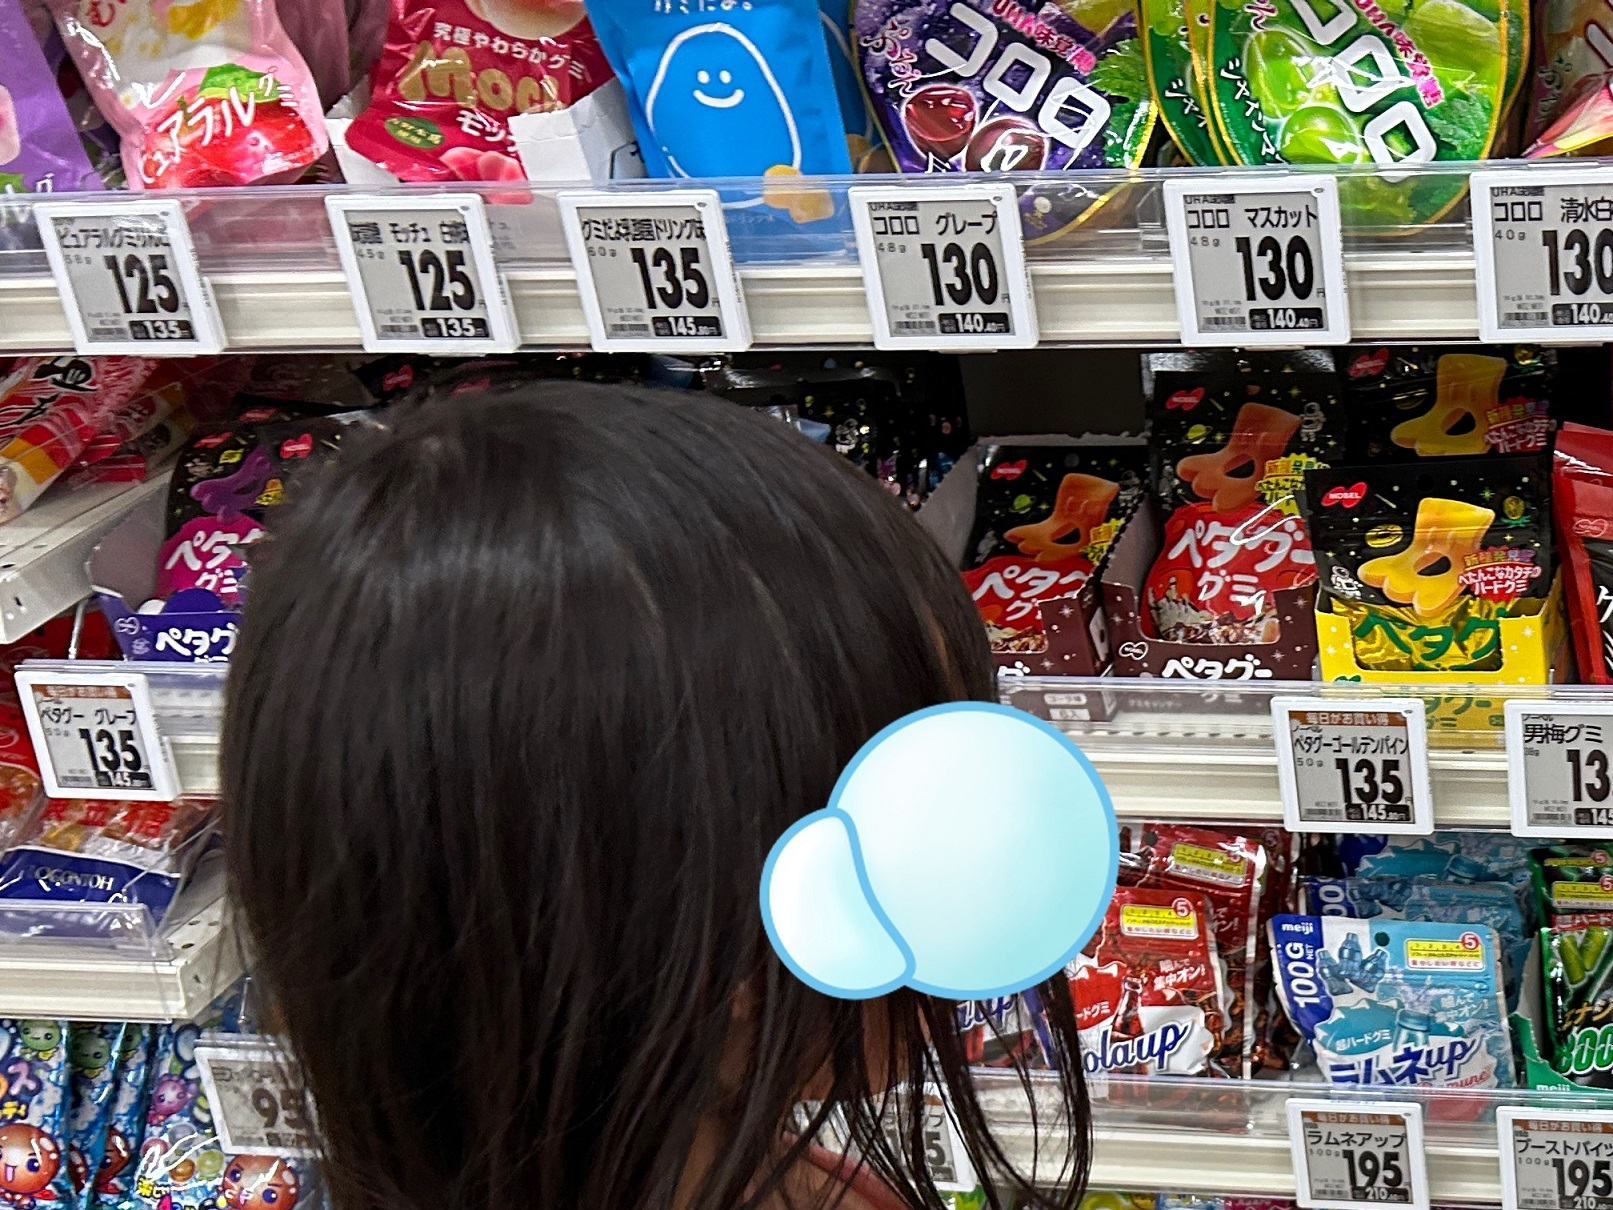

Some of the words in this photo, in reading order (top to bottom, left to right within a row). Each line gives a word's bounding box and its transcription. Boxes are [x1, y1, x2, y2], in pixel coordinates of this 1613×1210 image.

[925, 2, 1111, 149] コロロ
[873, 216, 920, 235] コロロ
[936, 211, 998, 235] グレープ
[1187, 209, 1230, 228] コロロ
[1244, 205, 1317, 228] マスカット
[1494, 202, 1543, 222] コロロ
[104, 254, 179, 313] 125
[398, 249, 476, 310] 125
[630, 247, 709, 309] 135
[921, 242, 998, 306] 130
[1235, 235, 1314, 301] 130
[1168, 520, 1316, 572] ペタグー
[1198, 573, 1259, 601] グミ
[1162, 654, 1274, 679] ペタグー
[79, 728, 141, 771] 135
[1295, 735, 1408, 754] ペタグーゴールデンパイン
[1525, 724, 1603, 744] 男梅グミ
[1335, 758, 1403, 804] 135
[1281, 922, 1314, 935] meiji
[1285, 942, 1322, 1008] 100G
[1307, 1131, 1406, 1148] ラムネアップ
[1343, 1150, 1403, 1187] 195
[1552, 1158, 1613, 1197] 195
